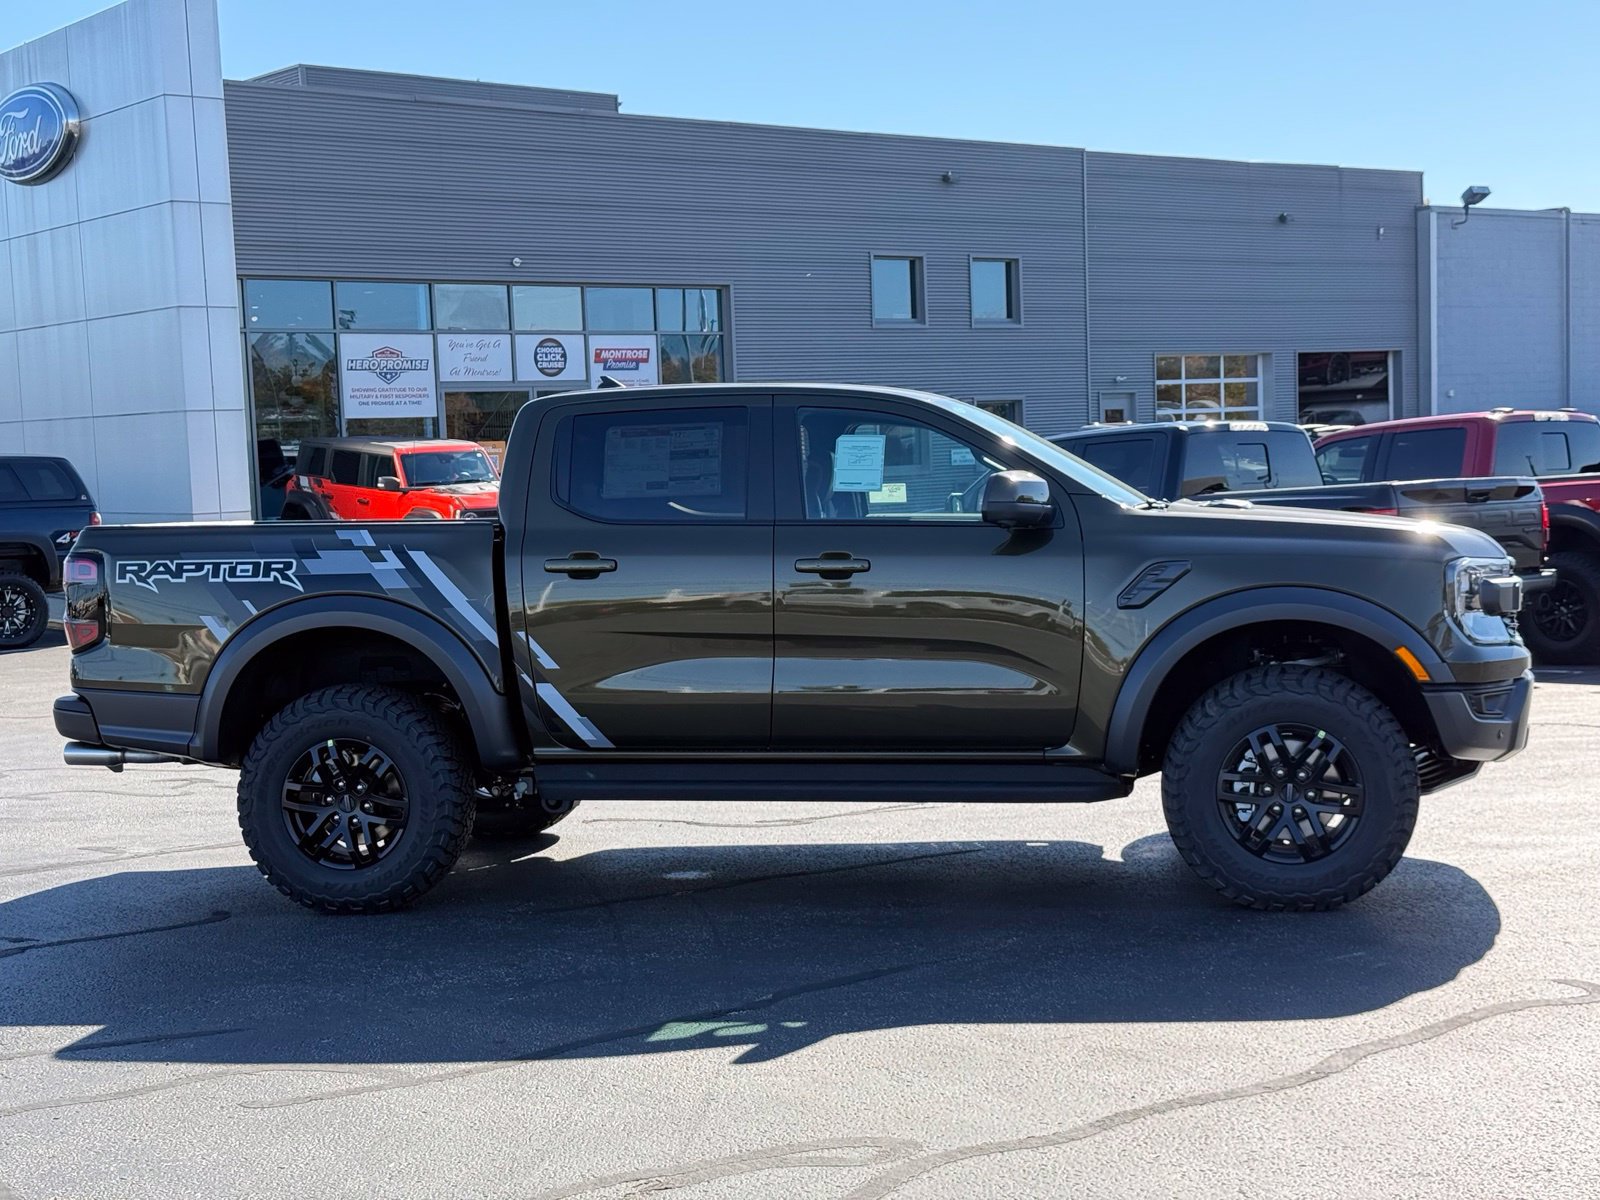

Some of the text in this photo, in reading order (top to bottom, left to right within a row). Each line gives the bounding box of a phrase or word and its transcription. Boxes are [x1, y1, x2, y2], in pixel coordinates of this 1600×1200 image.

[0, 107, 42, 167] Ford
[448, 339, 501, 351] You've Got A
[463, 352, 488, 362] Friend
[537, 353, 564, 361] CLICK.
[600, 350, 648, 359] MONTROSE
[347, 360, 428, 370] HERO PROMISE
[606, 359, 637, 369] Promise
[449, 365, 502, 376] At Montrose!
[115, 558, 305, 594] RAPTOR
